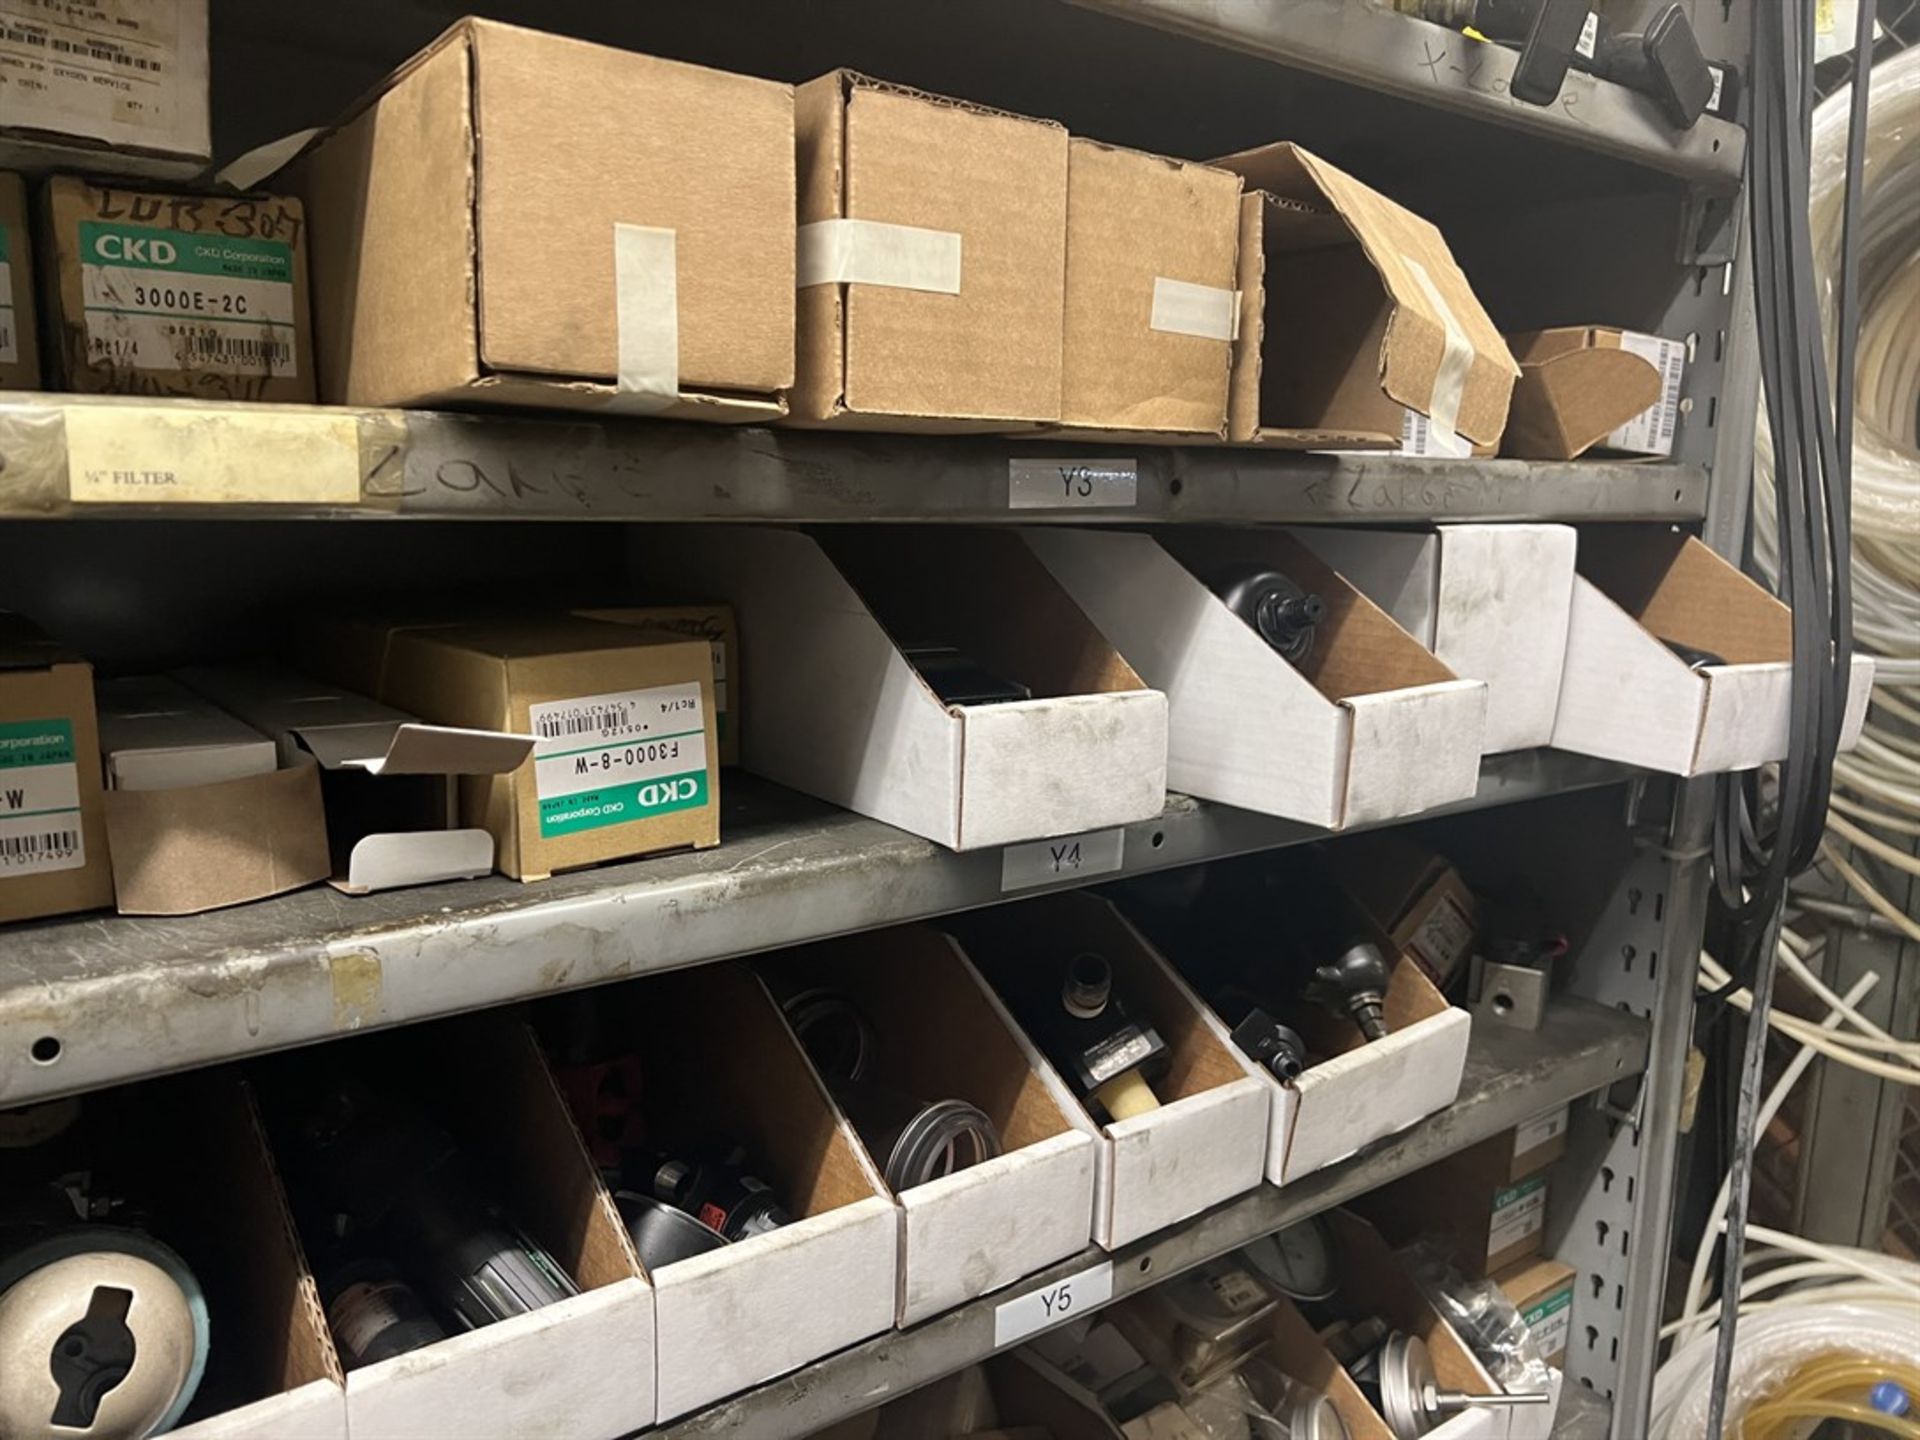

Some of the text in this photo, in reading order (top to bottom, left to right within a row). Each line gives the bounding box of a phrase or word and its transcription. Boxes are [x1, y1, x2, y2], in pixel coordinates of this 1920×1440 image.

[95, 234, 177, 265] CKD
[223, 249, 286, 265] Corporation
[135, 287, 248, 314] 3000E-2C
[112, 470, 178, 485] FILTER
[1058, 466, 1093, 497] Y3
[660, 699, 696, 713] Rc1/4
[0, 734, 65, 749] orporation
[575, 742, 679, 775] F3000-8-W
[638, 778, 698, 807] CKD
[546, 801, 625, 824] CKD Corporation
[1051, 842, 1082, 872] Y4
[1041, 1284, 1072, 1317] Y5
